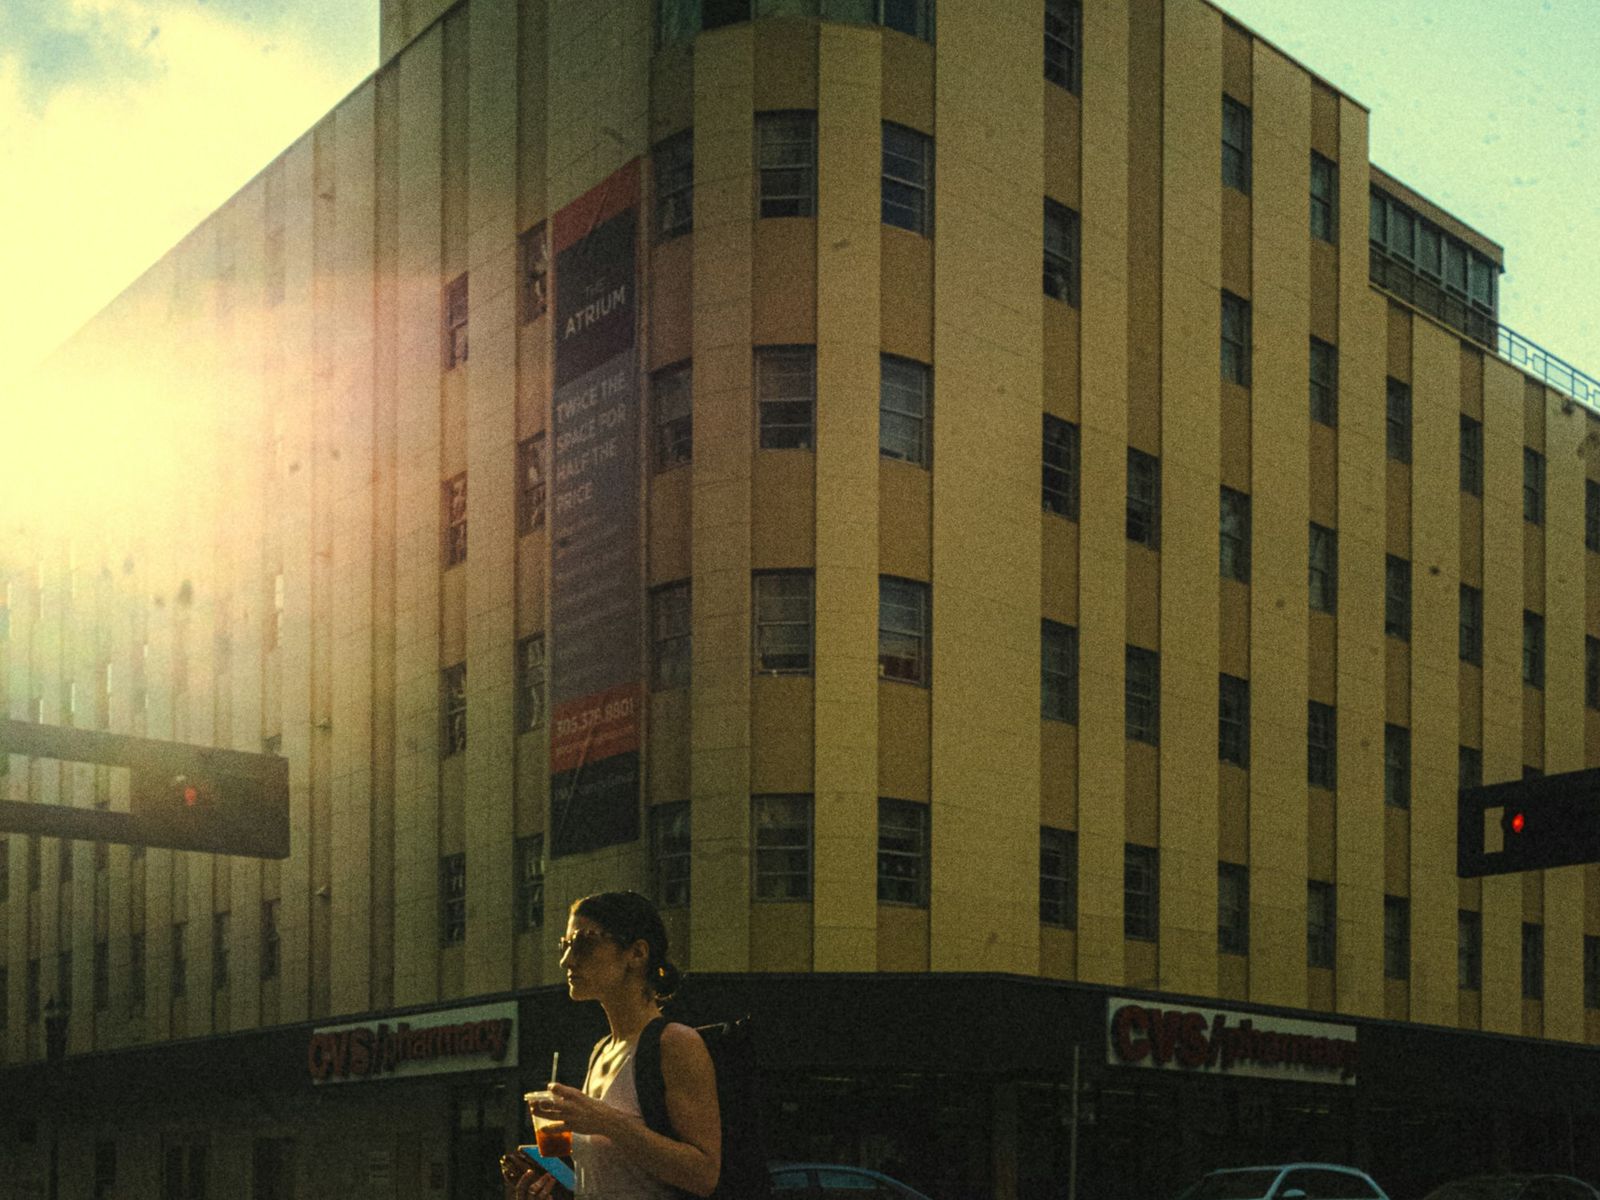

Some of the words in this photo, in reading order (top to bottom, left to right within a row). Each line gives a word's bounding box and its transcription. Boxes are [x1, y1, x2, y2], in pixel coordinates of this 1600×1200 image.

[564, 285, 625, 339] ATRIUM
[556, 385, 598, 423] TWICE
[600, 370, 626, 400] THE
[556, 418, 595, 453] SPACE
